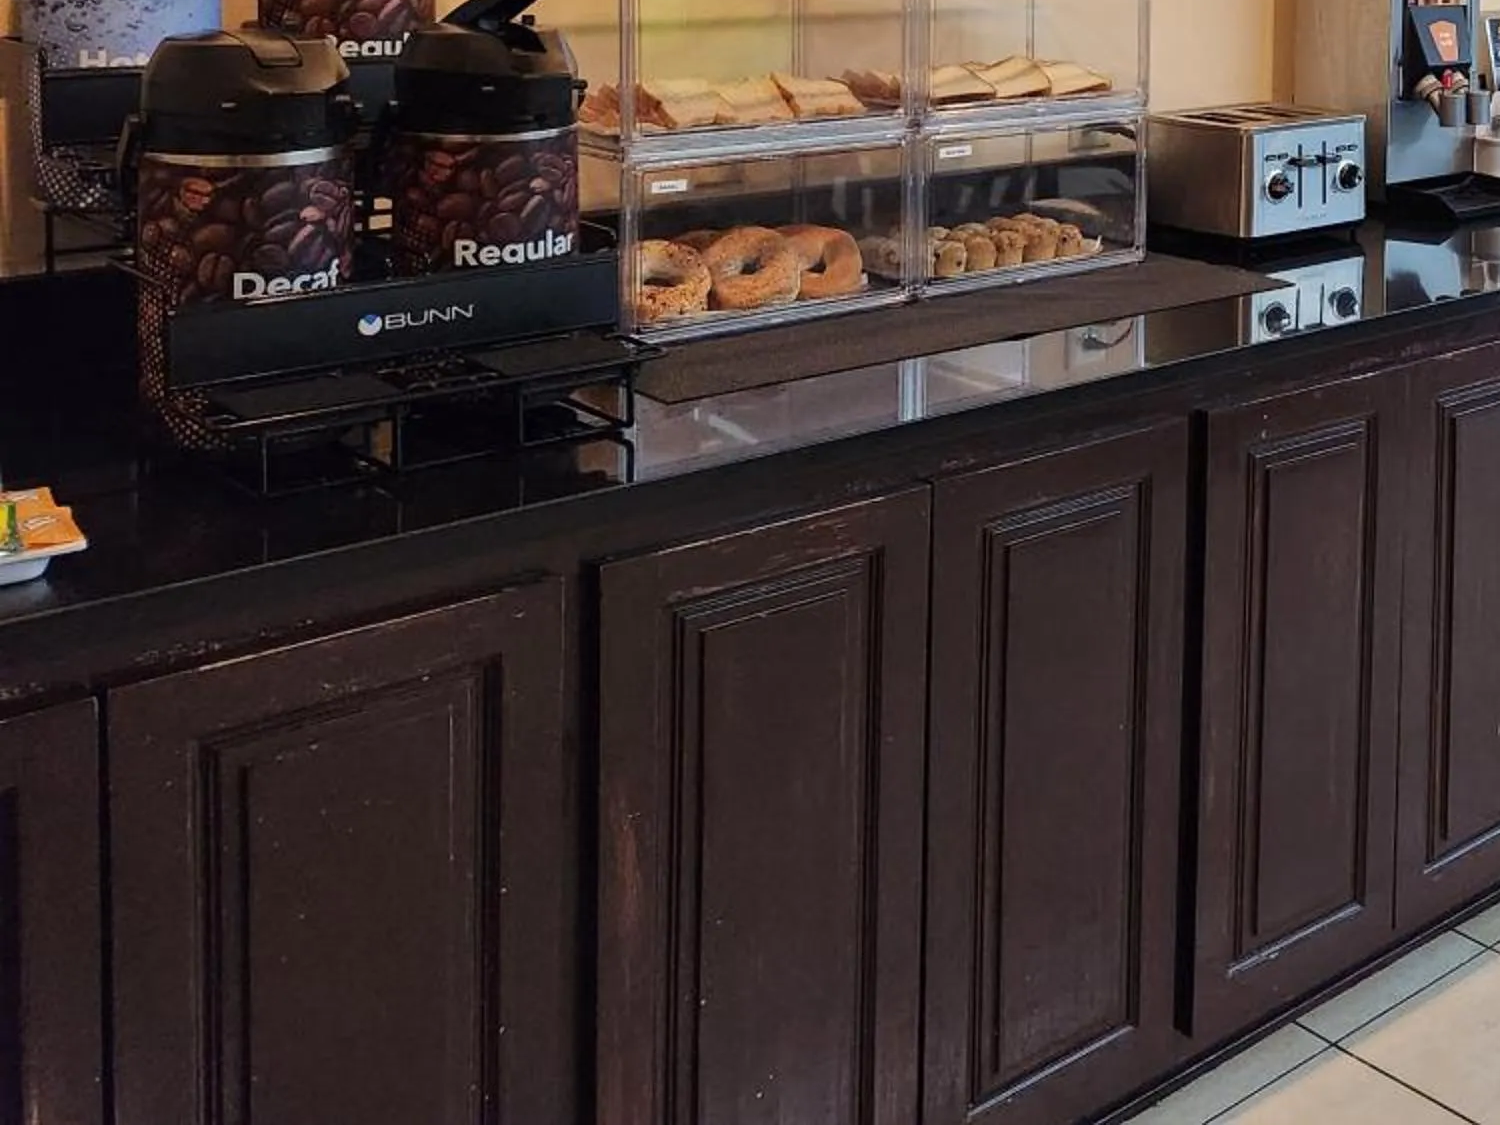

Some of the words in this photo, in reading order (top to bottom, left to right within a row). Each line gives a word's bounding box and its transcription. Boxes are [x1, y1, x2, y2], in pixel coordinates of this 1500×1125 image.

[454, 228, 574, 267] Regular
[233, 257, 340, 300] Decaf
[384, 303, 475, 330] BUNN
